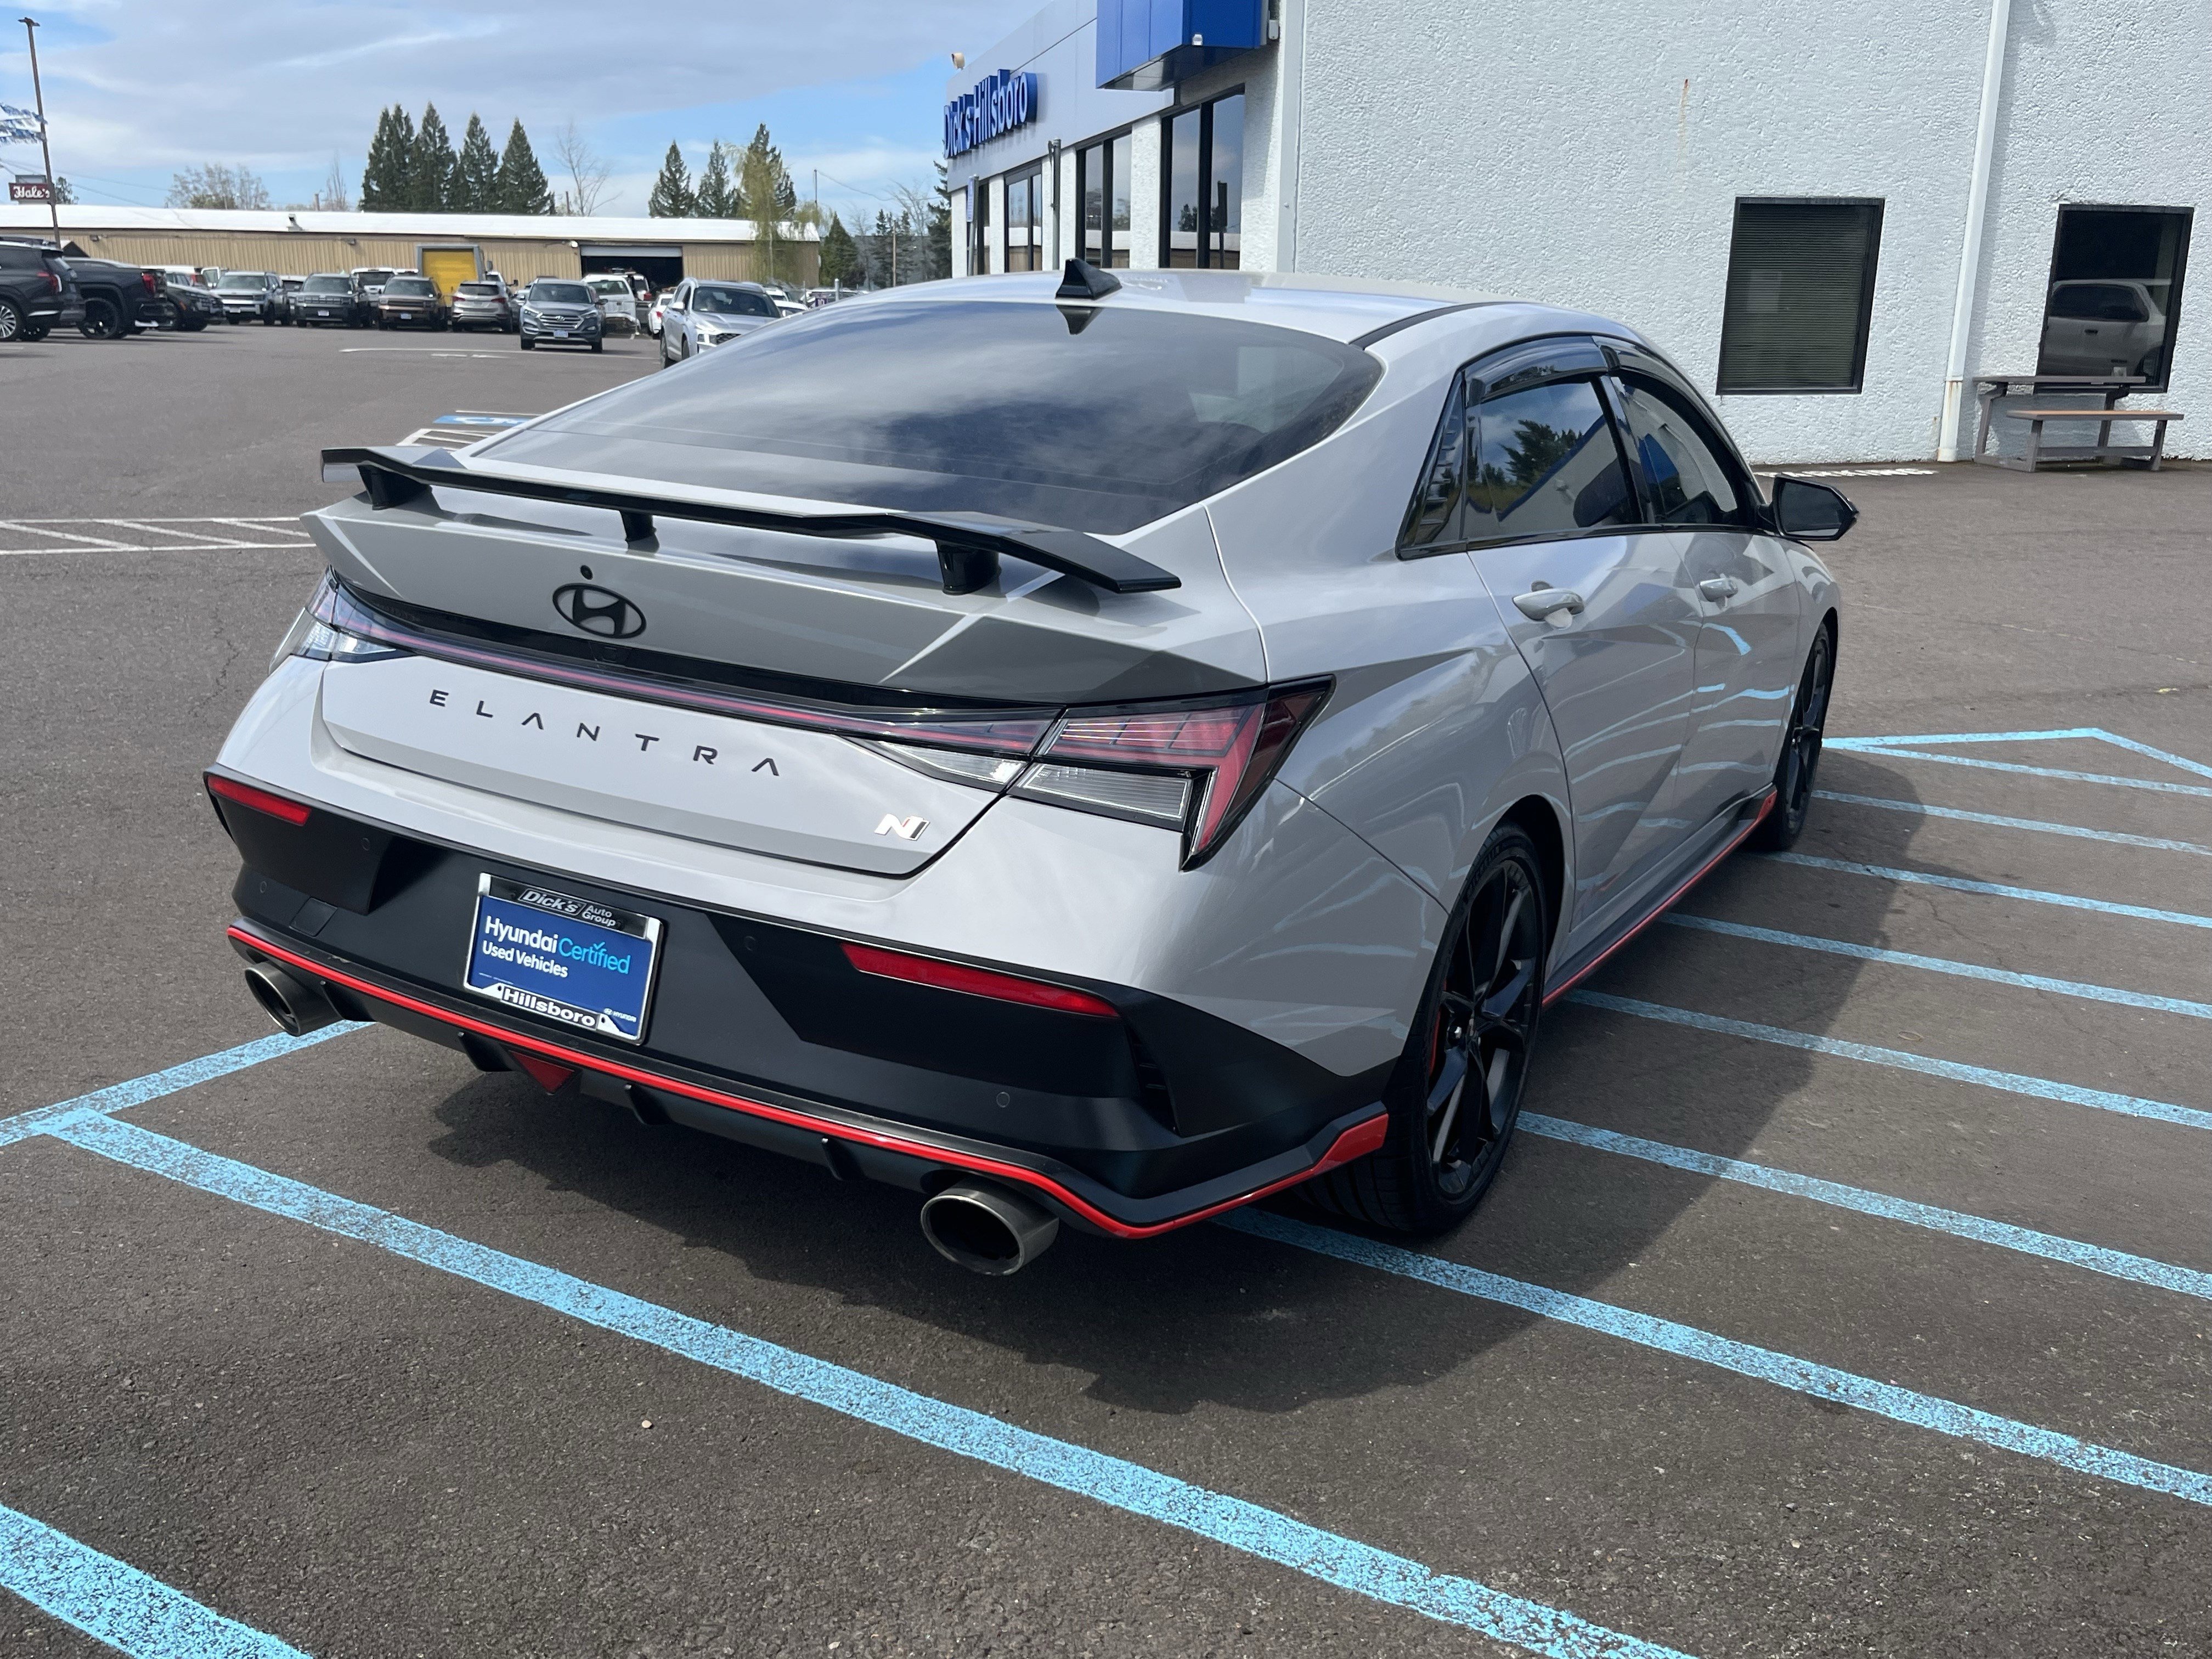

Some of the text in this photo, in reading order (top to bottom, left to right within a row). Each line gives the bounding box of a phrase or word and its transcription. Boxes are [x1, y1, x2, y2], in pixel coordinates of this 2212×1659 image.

[973, 69, 1037, 145] Hillsboro
[430, 689, 780, 776] ELANTRA
[522, 890, 579, 913] Dick's
[582, 911, 617, 927] Group
[585, 905, 612, 918] Auto
[482, 940, 568, 978] Used Vehicles
[485, 915, 631, 974] Hyundai Certified
[504, 988, 596, 1027] Hillsboro
